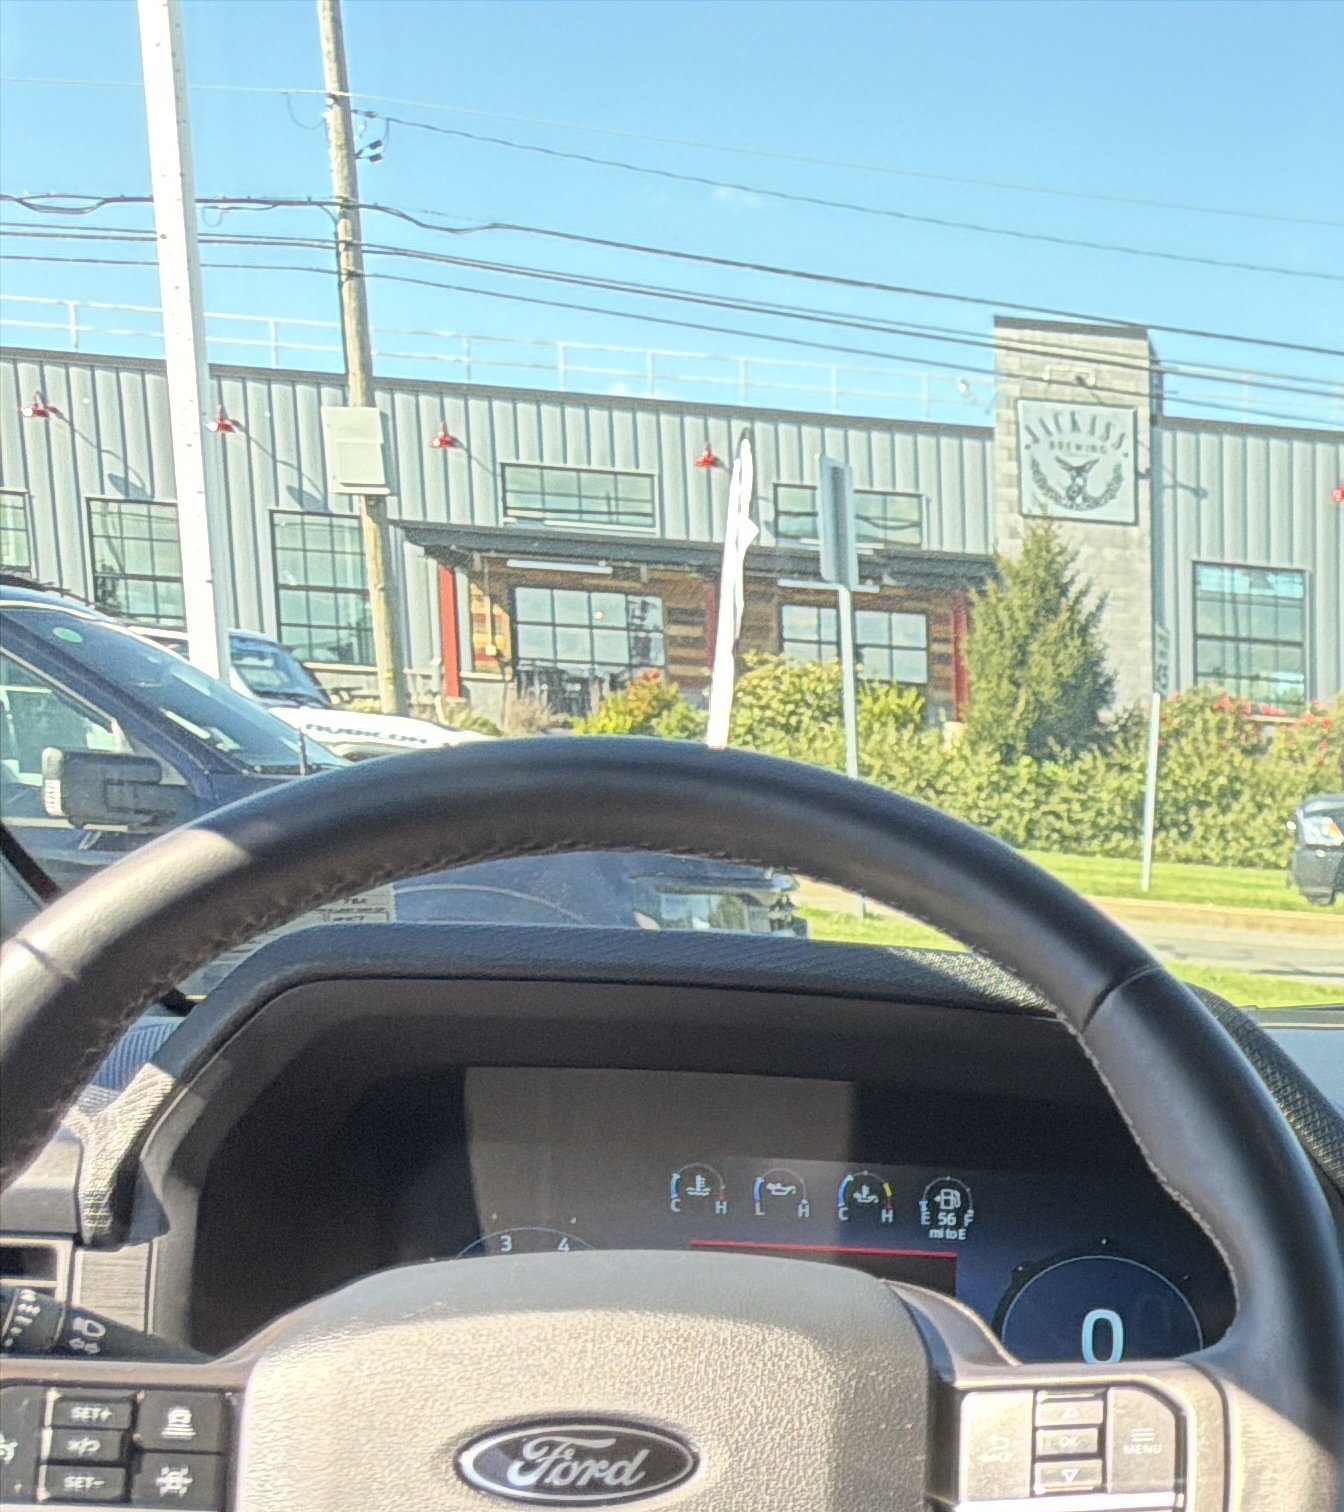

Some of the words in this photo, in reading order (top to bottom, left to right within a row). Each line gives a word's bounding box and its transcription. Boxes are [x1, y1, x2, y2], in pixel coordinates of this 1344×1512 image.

[670, 1199, 681, 1213] C
[715, 1201, 728, 1215] H
[755, 1202, 766, 1216] L
[797, 1203, 810, 1218] H
[837, 1206, 849, 1221] C
[881, 1209, 894, 1223] H
[920, 1212, 930, 1225] E
[937, 1213, 957, 1226] 56
[500, 1233, 513, 1252] 3
[557, 1236, 571, 1252] 4
[1081, 1308, 1124, 1365] 0
[1123, 1443, 1162, 1455] MENU
[506, 1435, 650, 1487] Ford
